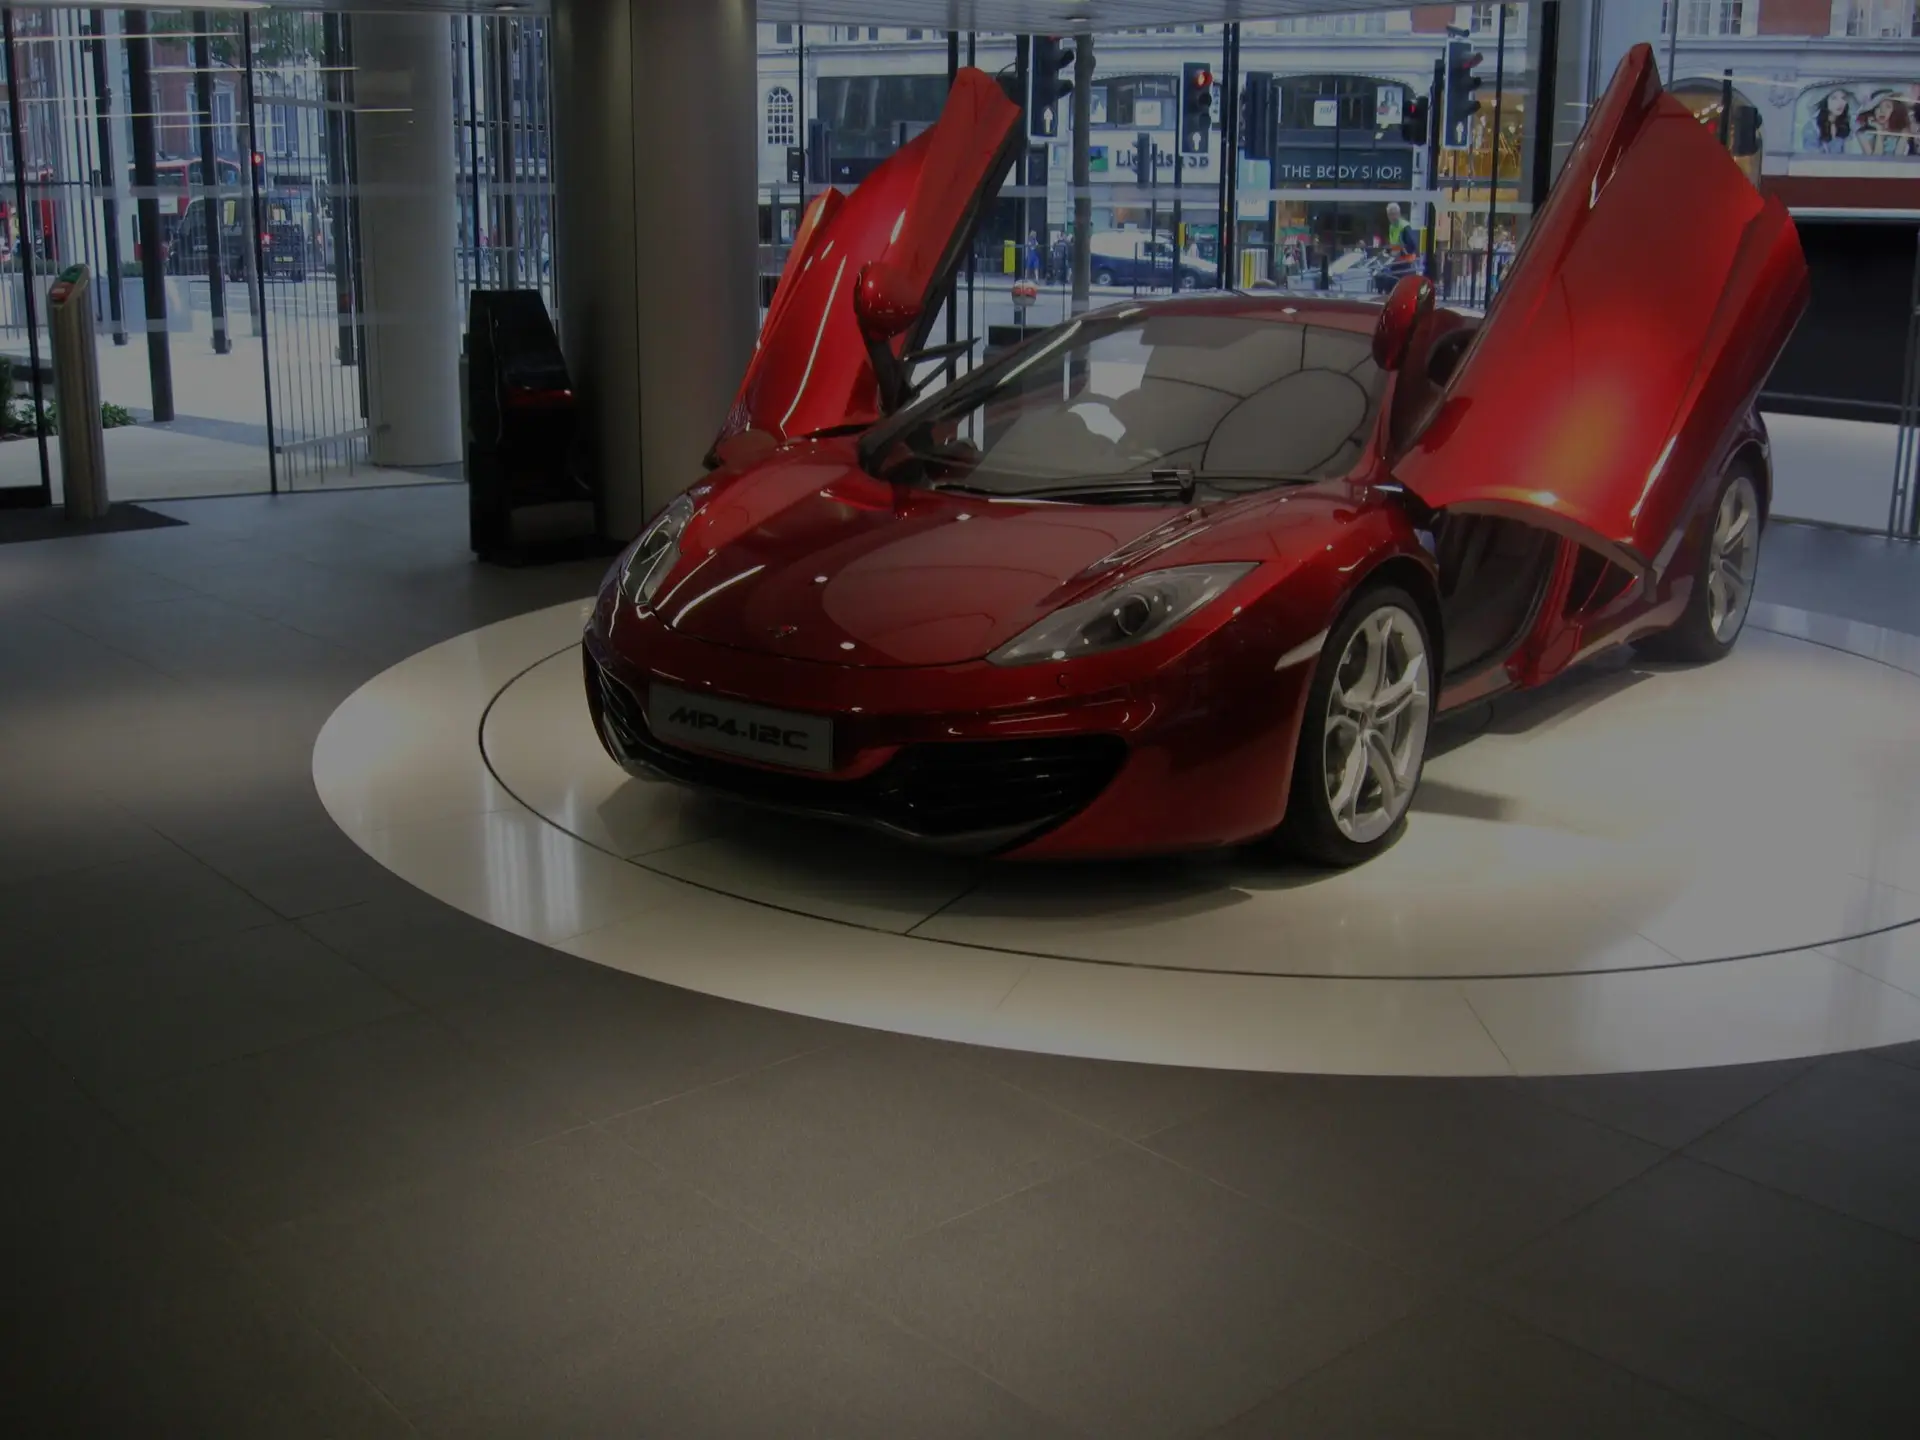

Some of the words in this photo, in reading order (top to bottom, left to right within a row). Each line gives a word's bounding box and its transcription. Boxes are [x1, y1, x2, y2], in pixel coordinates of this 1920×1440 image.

[1115, 149, 1173, 168] Llods
[1281, 163, 1311, 178] THE
[1316, 164, 1359, 179] BODY
